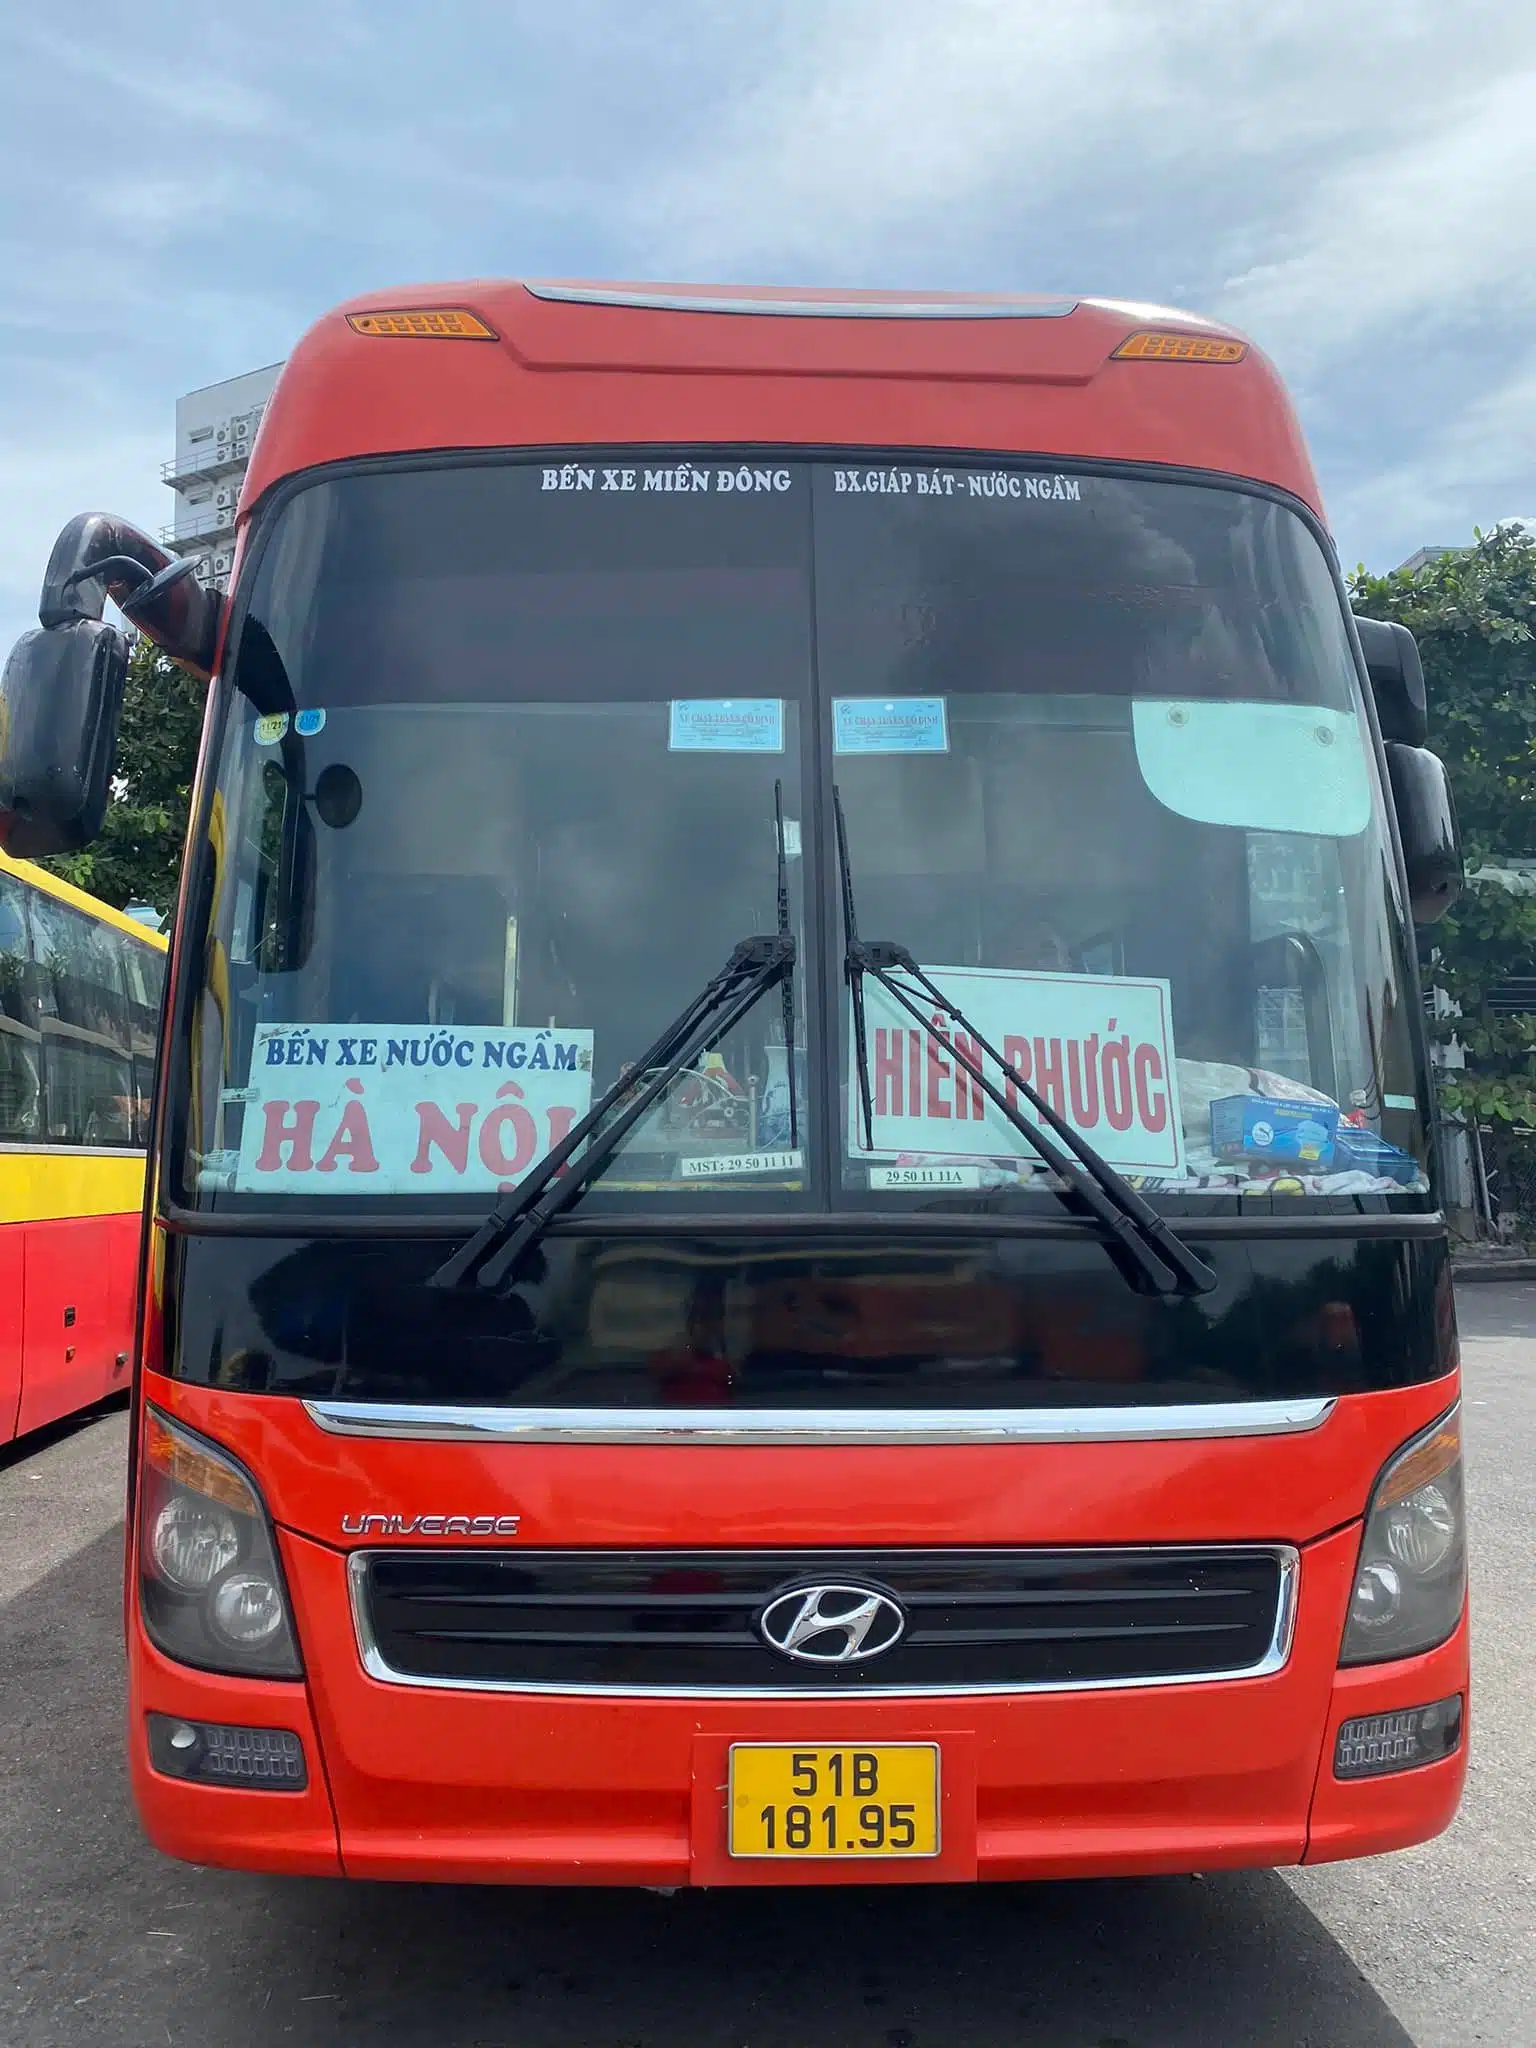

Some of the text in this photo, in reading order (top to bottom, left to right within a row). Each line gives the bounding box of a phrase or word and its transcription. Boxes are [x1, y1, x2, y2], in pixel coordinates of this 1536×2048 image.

[541, 462, 792, 492] BẾN XE MIỀN ĐÔNG
[834, 467, 912, 494] BX.GIÁP
[917, 468, 955, 495] BÁT
[968, 471, 1021, 498] NƯỚC
[1025, 474, 1082, 501] NGẦM
[265, 1028, 578, 1071] BẾN XE NƯỚC NGẦM
[1003, 1018, 1167, 1134] PHƯỚC
[255, 1077, 380, 1173] HÀ
[688, 1155, 793, 1174] MST: 29 50 11 11
[886, 1170, 963, 1182] 29 50 11 11A
[341, 1514, 521, 1536] UNIVERSE
[792, 1753, 879, 1797] 51B
[761, 1804, 916, 1849] 181.95
